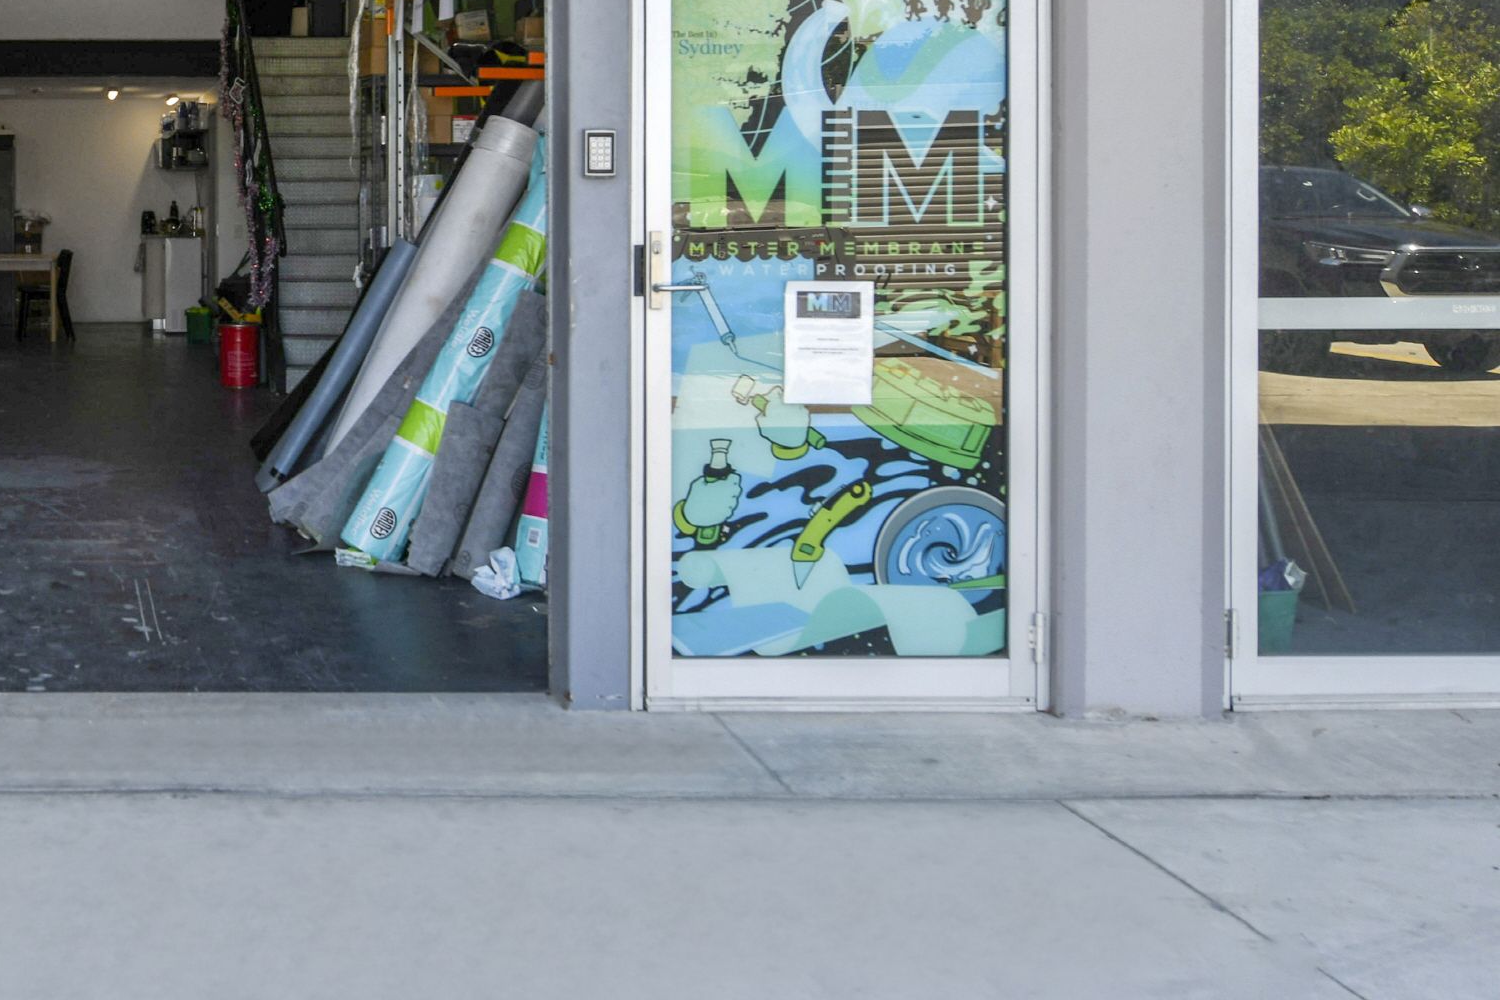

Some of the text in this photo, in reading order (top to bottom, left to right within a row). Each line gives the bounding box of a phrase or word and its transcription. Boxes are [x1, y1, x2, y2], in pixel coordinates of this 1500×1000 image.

[679, 39, 743, 59] Sydney
[690, 241, 984, 256] MISTER MEMBRANE
[720, 263, 956, 276] WATERPROOFING
[470, 329, 491, 355] ARDEX
[374, 510, 394, 536] ARDEX
